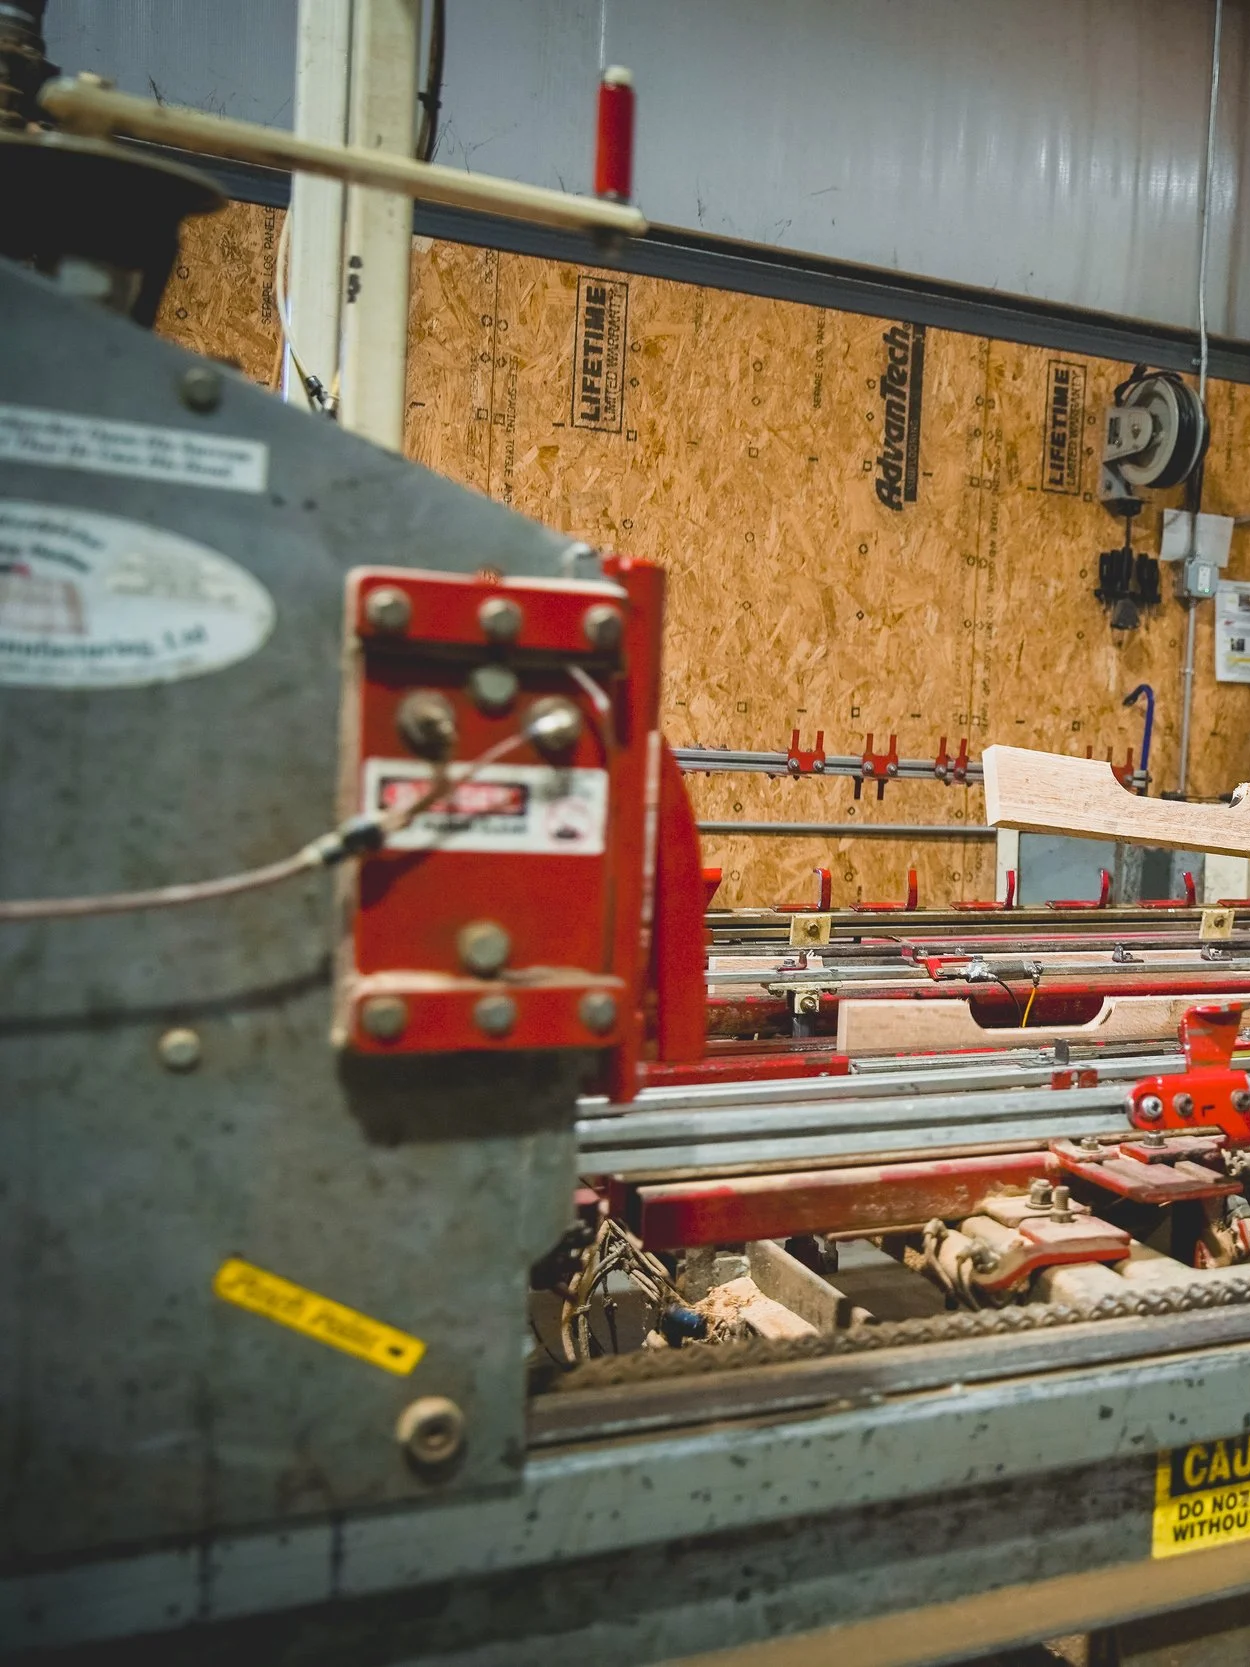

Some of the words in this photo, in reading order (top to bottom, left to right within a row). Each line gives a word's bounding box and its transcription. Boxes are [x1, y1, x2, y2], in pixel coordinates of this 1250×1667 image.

[580, 286, 606, 421] LIFETIME
[1048, 368, 1069, 486] LIFETIME
[1178, 1499, 1204, 1521] DO
[1211, 1490, 1250, 1514] NOT
